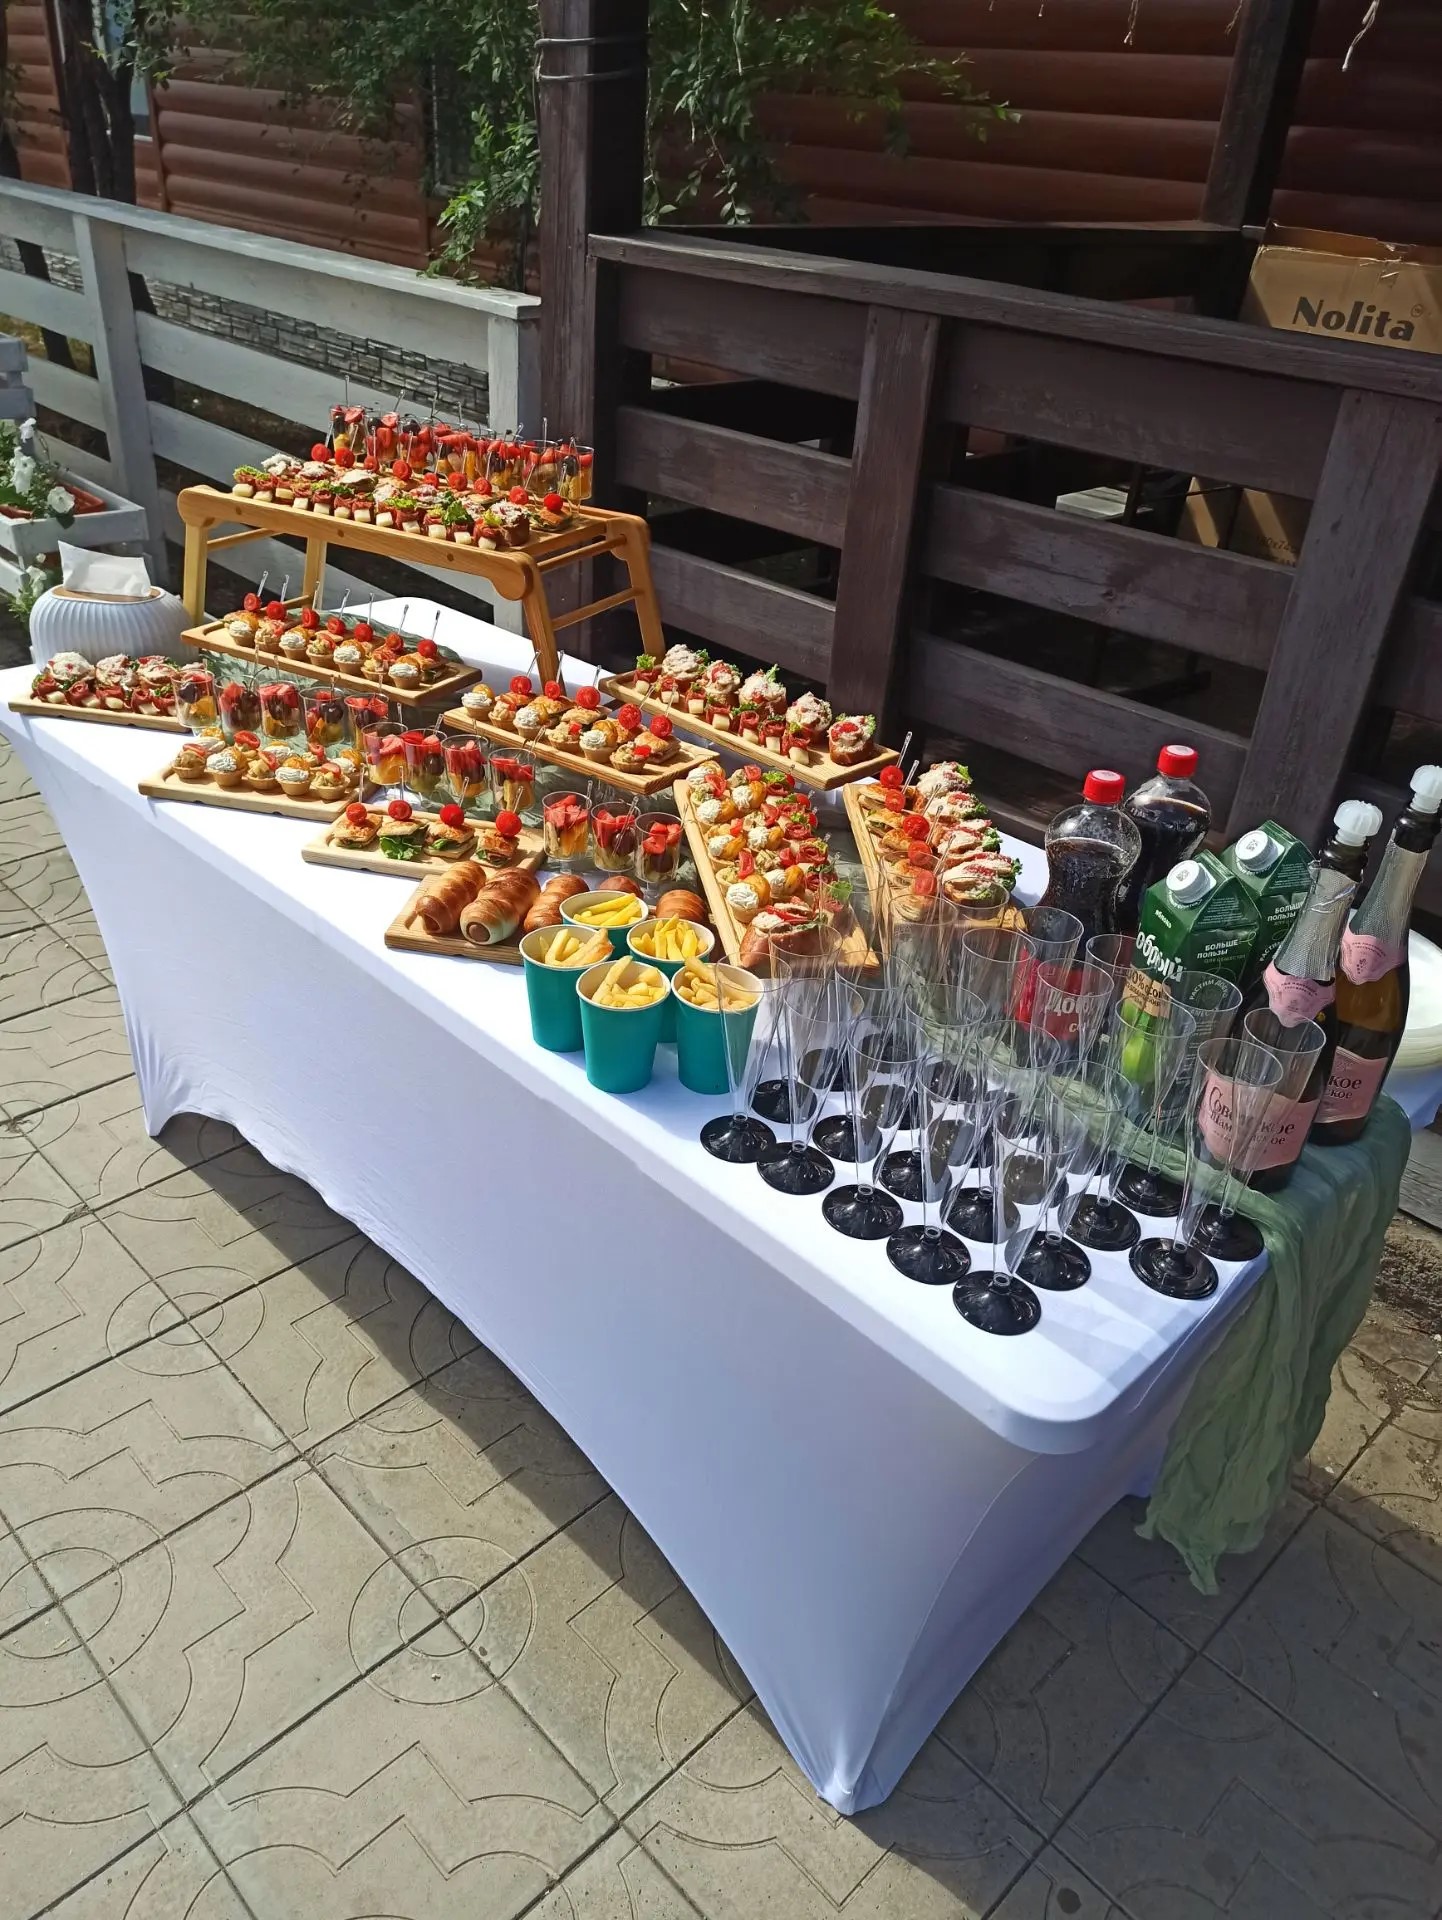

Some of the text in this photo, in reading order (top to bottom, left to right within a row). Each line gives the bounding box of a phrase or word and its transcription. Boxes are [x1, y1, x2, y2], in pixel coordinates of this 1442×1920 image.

[1292, 296, 1416, 342] Nolita
[1135, 930, 1185, 983] обрый
[1196, 948, 1229, 960] ПОЛЬЗЫ
[1204, 938, 1239, 952] БОЛЬШЕ
